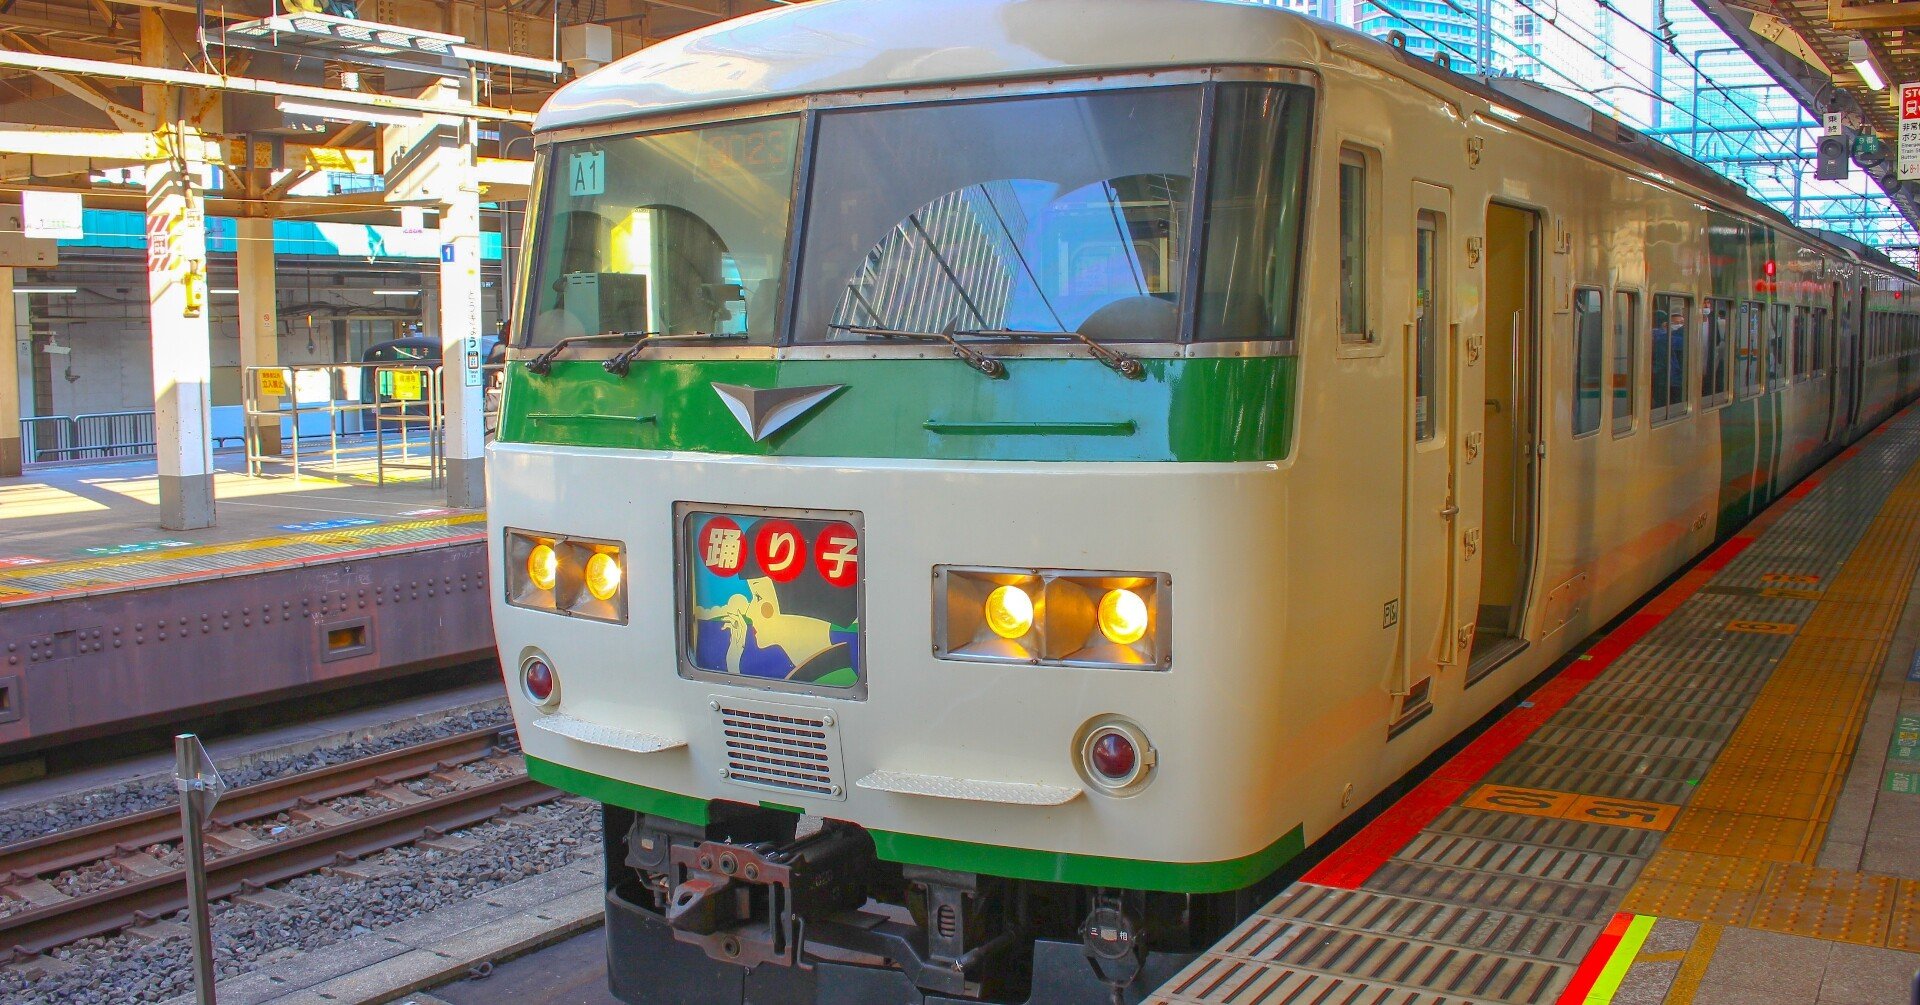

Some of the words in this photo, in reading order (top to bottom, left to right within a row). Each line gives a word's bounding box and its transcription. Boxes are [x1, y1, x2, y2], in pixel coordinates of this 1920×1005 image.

[575, 160, 596, 191] A1
[445, 247, 451, 260] 1
[706, 528, 857, 578] 踊り子
